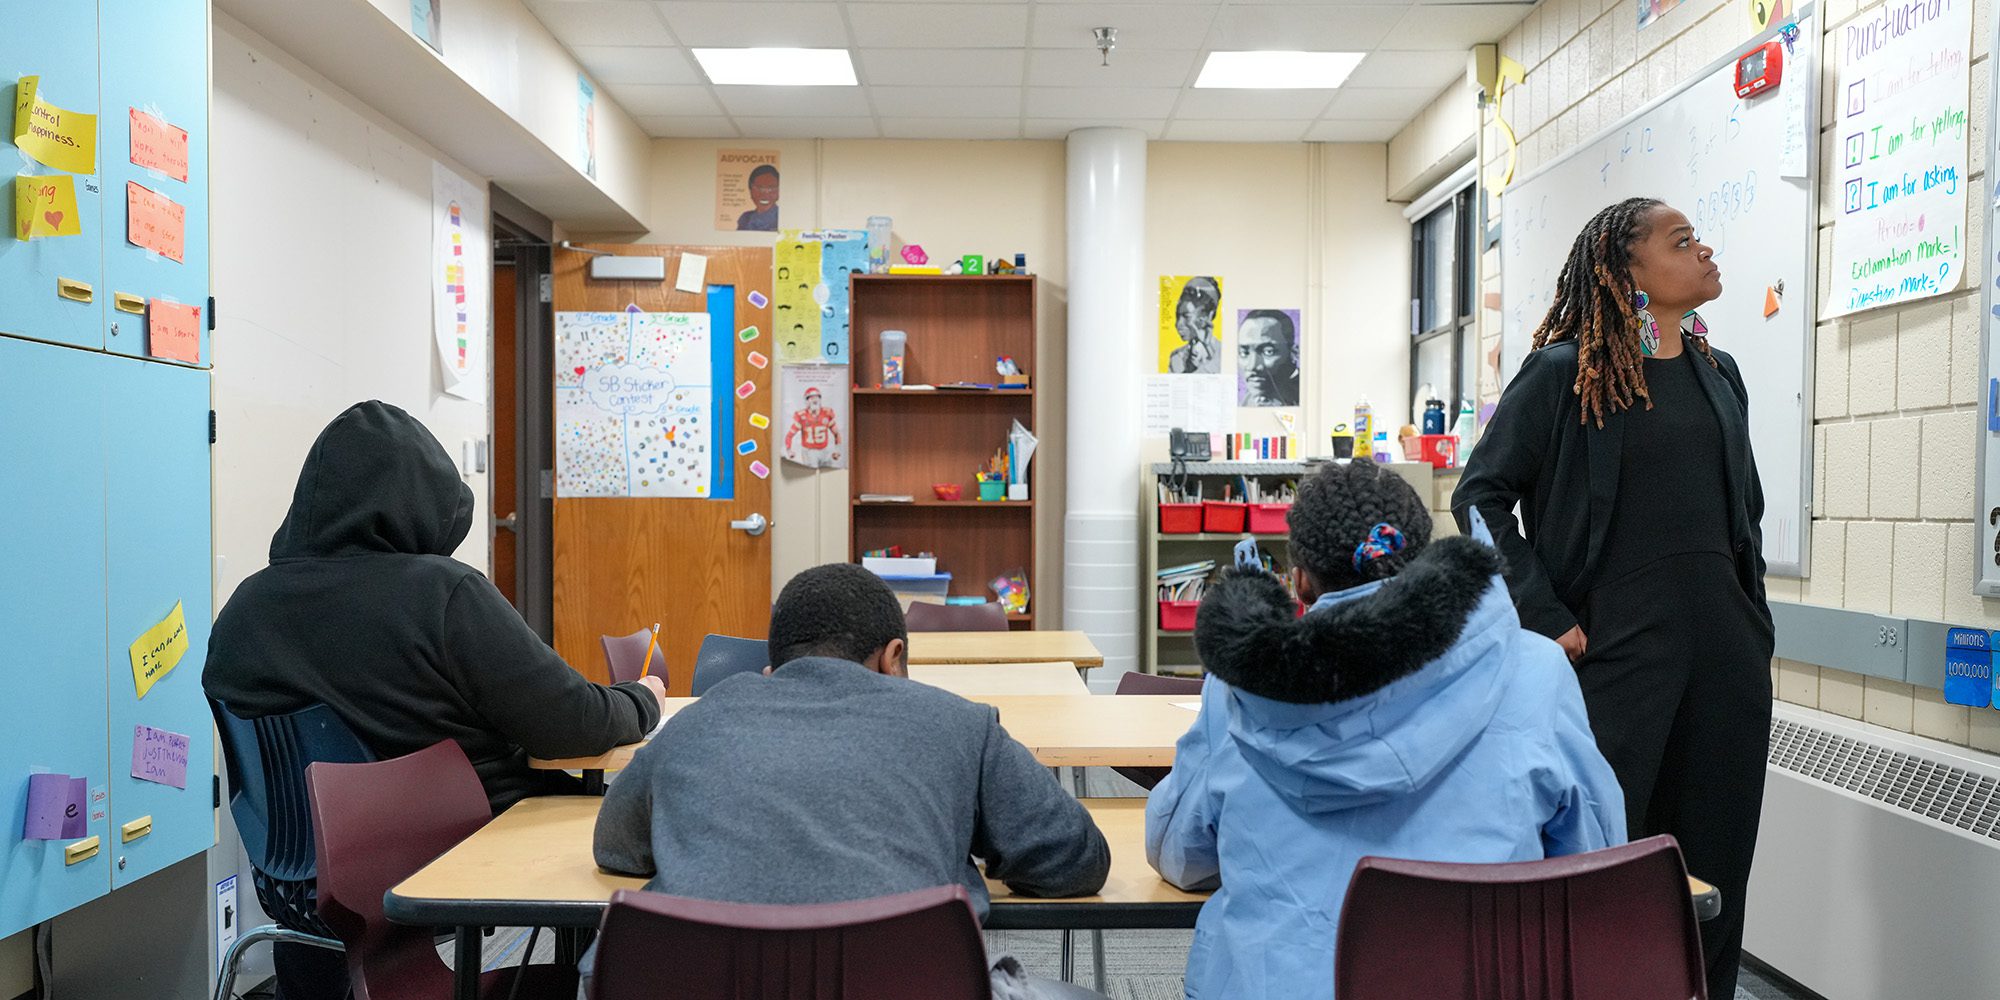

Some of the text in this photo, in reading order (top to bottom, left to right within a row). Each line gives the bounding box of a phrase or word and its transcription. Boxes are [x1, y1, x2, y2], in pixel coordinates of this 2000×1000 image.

[1869, 125, 1883, 160] I
[1888, 132, 1904, 156] am
[1910, 116, 1926, 141] for
[720, 154, 777, 164] ADVOCATE
[1866, 181, 1879, 210] I
[1882, 183, 1899, 204] am
[1901, 173, 1917, 195] for
[1923, 164, 1959, 195] asking.
[967, 258, 979, 272] 2
[1852, 247, 1912, 281] Exclamation
[806, 425, 827, 444] 15
[1953, 632, 1985, 648] Millions
[1948, 661, 1989, 679] 1,000,000
[146, 727, 152, 741] I
